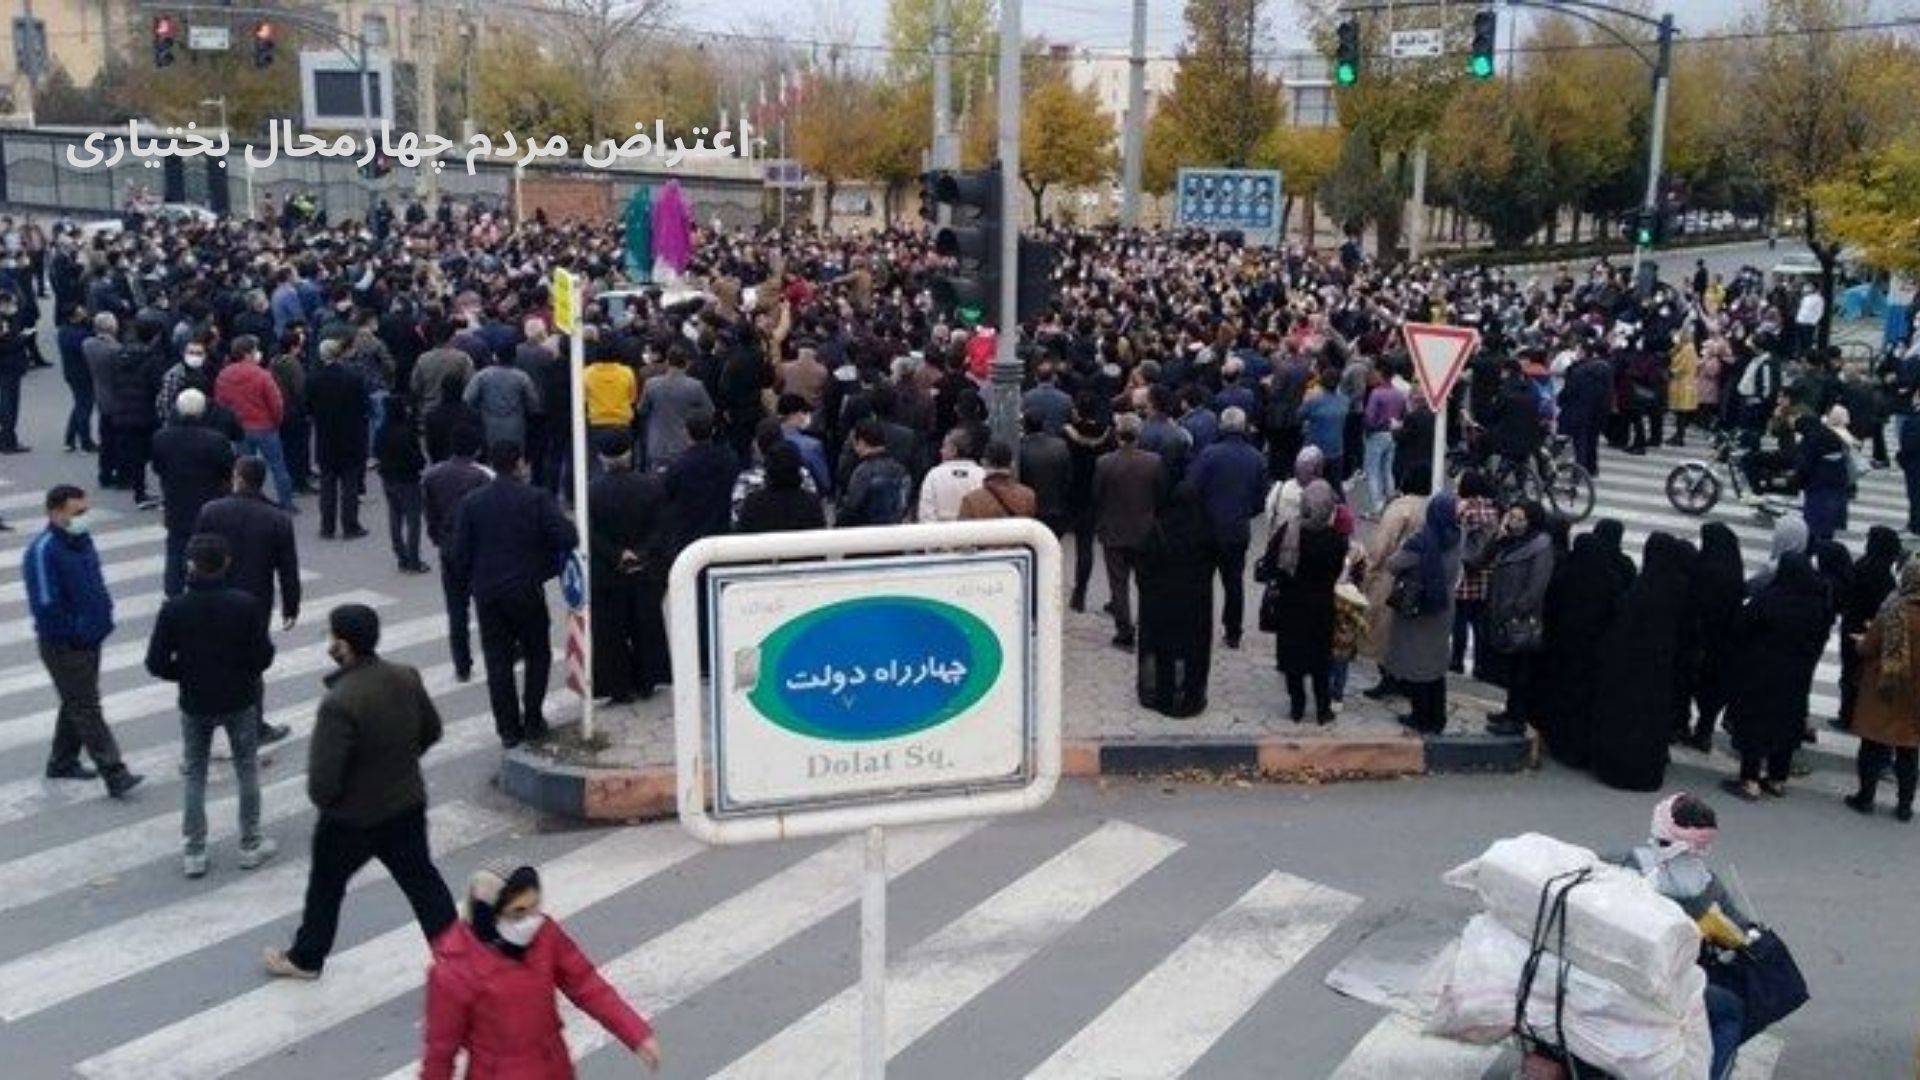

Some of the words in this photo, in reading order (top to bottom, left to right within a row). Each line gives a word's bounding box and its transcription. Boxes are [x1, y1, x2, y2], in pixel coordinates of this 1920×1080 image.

[786, 664, 866, 695] دولت
[806, 750, 891, 778] Dolat
[904, 744, 955, 770] Sq.
